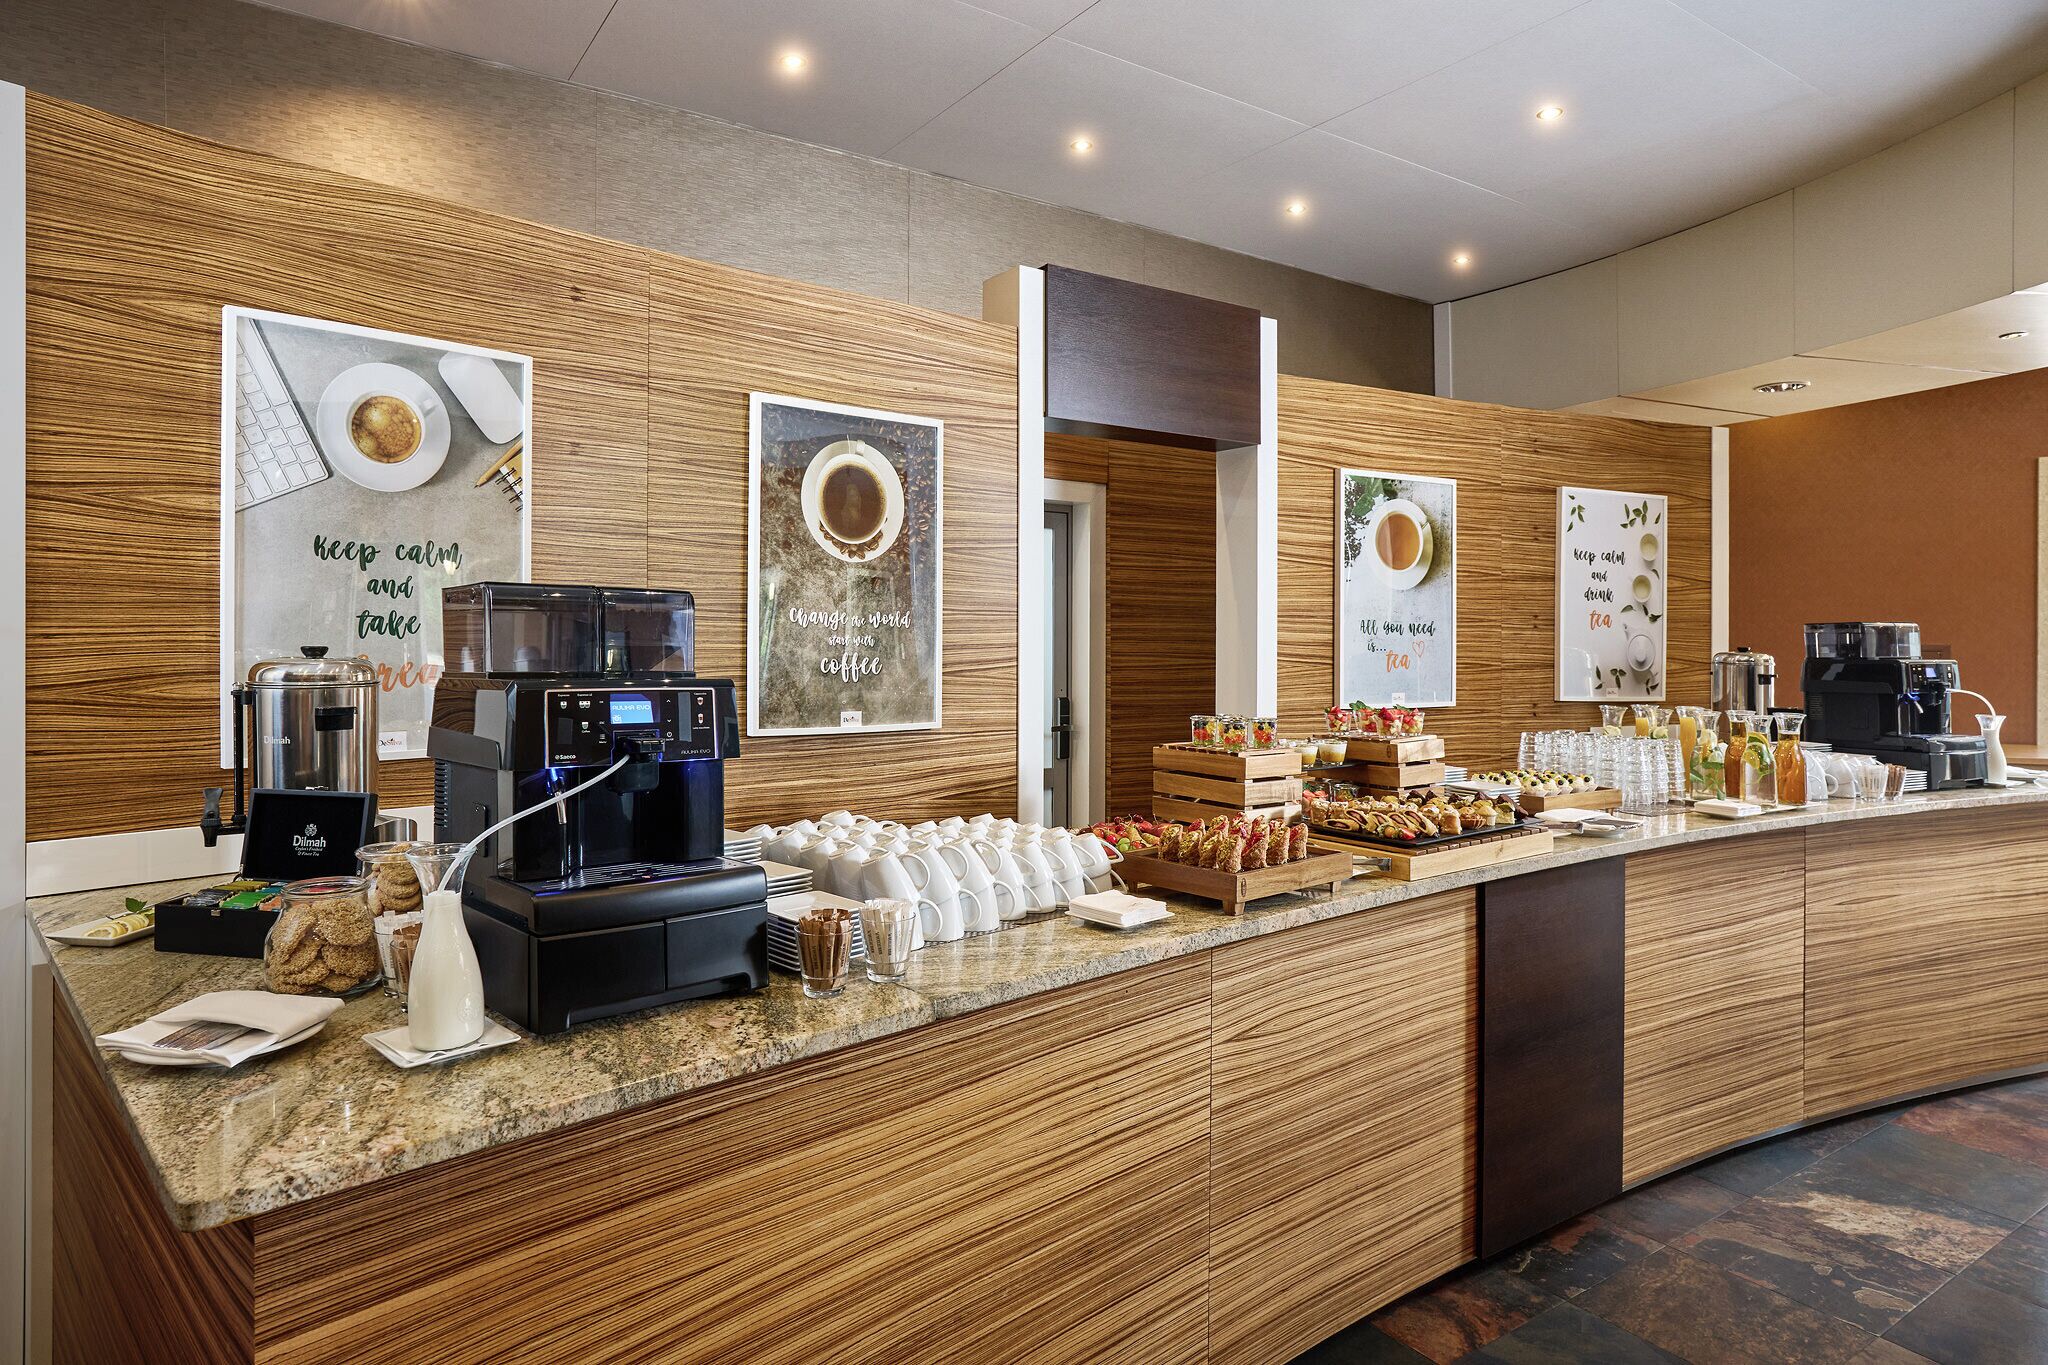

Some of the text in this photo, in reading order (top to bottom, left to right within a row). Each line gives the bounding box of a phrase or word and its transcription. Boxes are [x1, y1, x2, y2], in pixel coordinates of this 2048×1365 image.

[395, 540, 463, 570] calm
[1601, 550, 1626, 566] calm
[1591, 570, 1608, 582] and
[366, 575, 414, 599] and
[1584, 586, 1614, 603] drink
[356, 609, 421, 639] take
[789, 607, 911, 630] Change the world
[1360, 619, 1436, 637] All you need
[1589, 610, 1612, 630] tea
[828, 634, 875, 647] start with
[820, 652, 883, 683] coffee
[1386, 649, 1410, 673] tea
[263, 735, 291, 745] Dilmah
[292, 835, 327, 848] Dilmah
